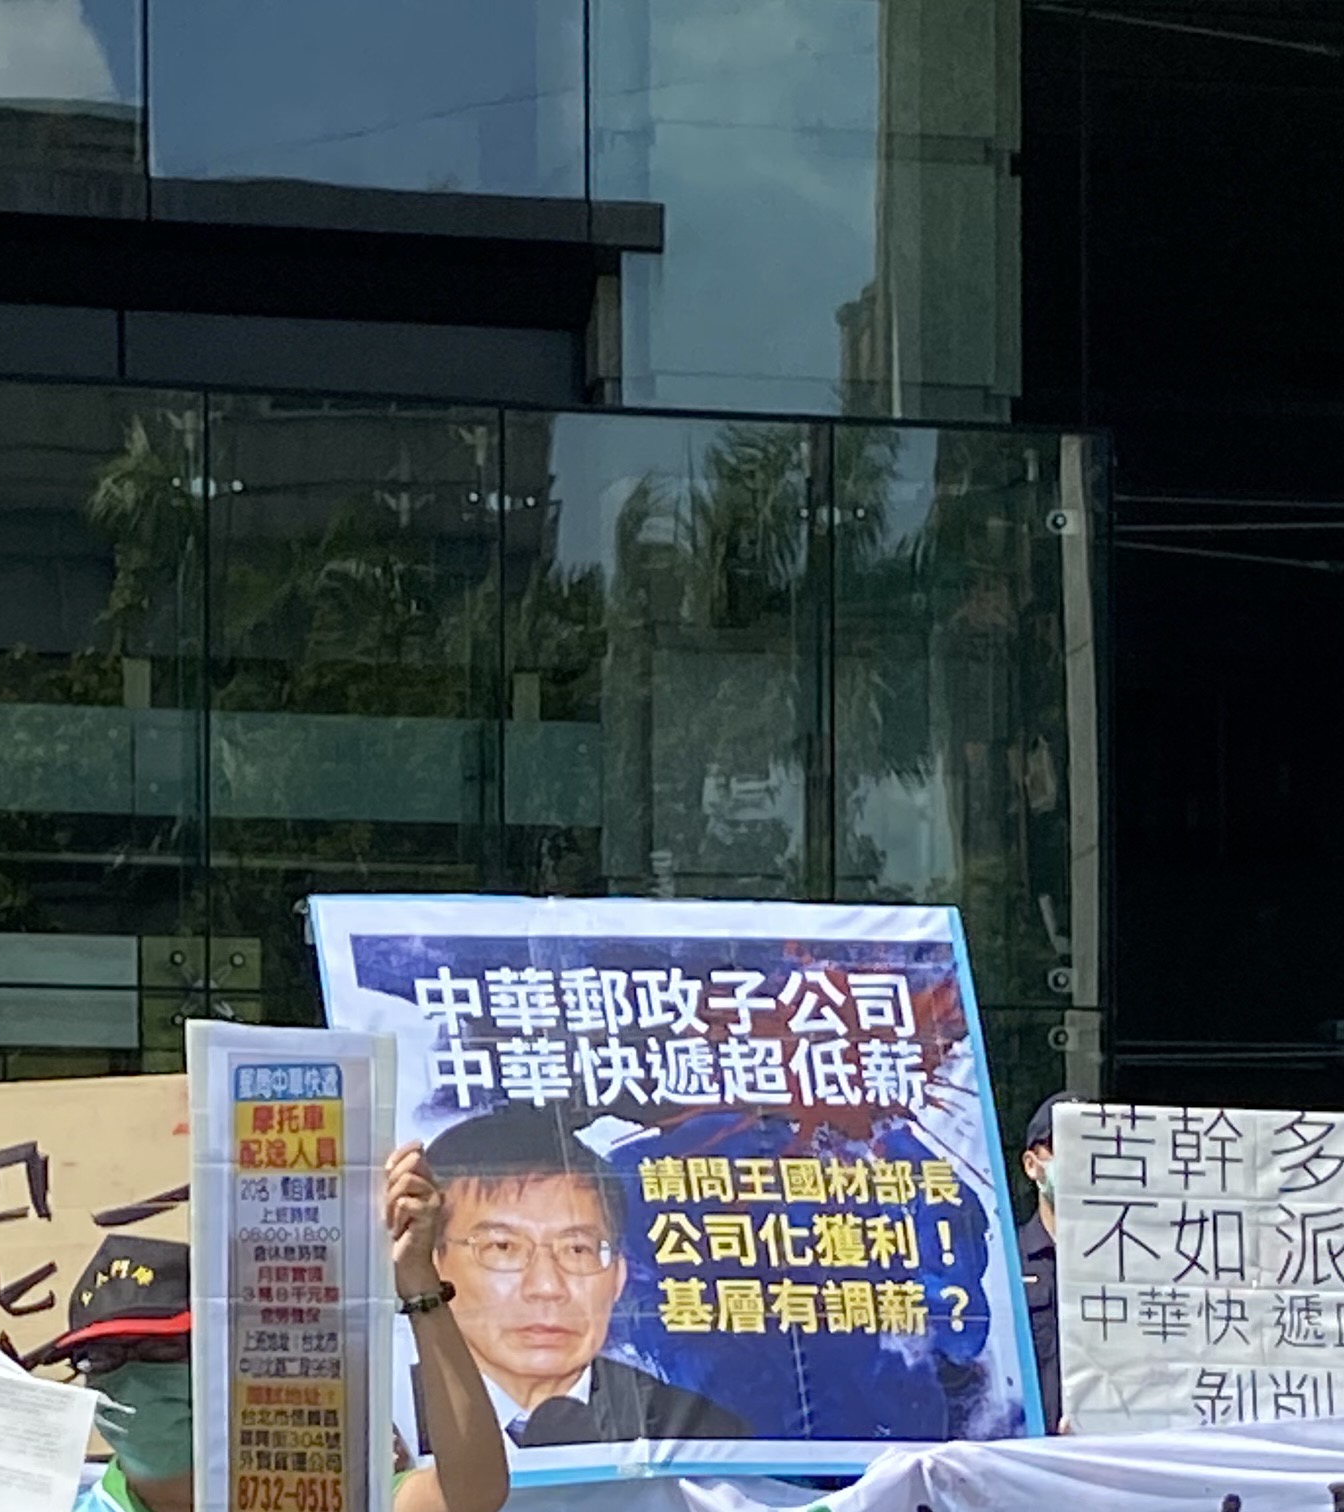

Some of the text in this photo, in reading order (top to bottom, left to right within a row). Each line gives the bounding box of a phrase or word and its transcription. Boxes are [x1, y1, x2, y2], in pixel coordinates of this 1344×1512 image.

[415, 966, 916, 1037] 中華郵政子公司
[431, 1037, 930, 1109] 中華快遞超低薪
[252, 1105, 324, 1134] 摩托車
[239, 1138, 338, 1168] 配送人員
[637, 1155, 962, 1204] 請問王國材部長
[647, 1213, 958, 1270] 公司化獲利！
[659, 1279, 970, 1334] 基層有調薪？
[238, 1476, 342, 1512] 8732-0515
